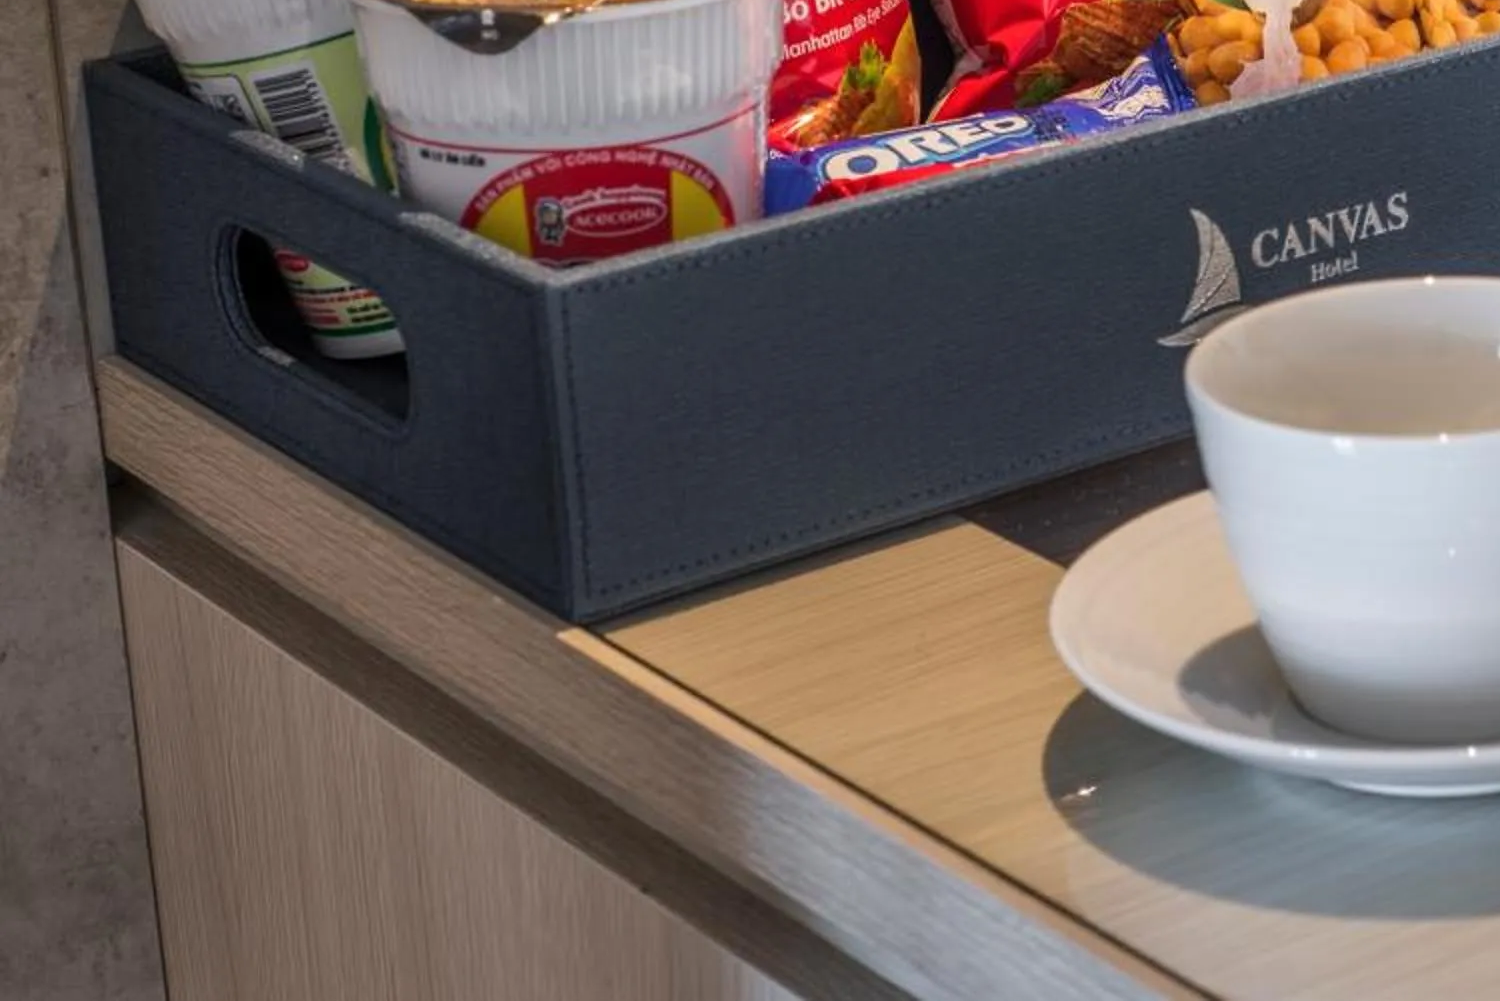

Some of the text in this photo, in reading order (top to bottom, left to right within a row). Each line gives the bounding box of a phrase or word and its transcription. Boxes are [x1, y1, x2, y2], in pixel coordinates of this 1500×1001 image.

[825, 115, 1032, 181] OREO
[1251, 192, 1410, 268] CANVAS
[1310, 250, 1361, 283] Hotel
